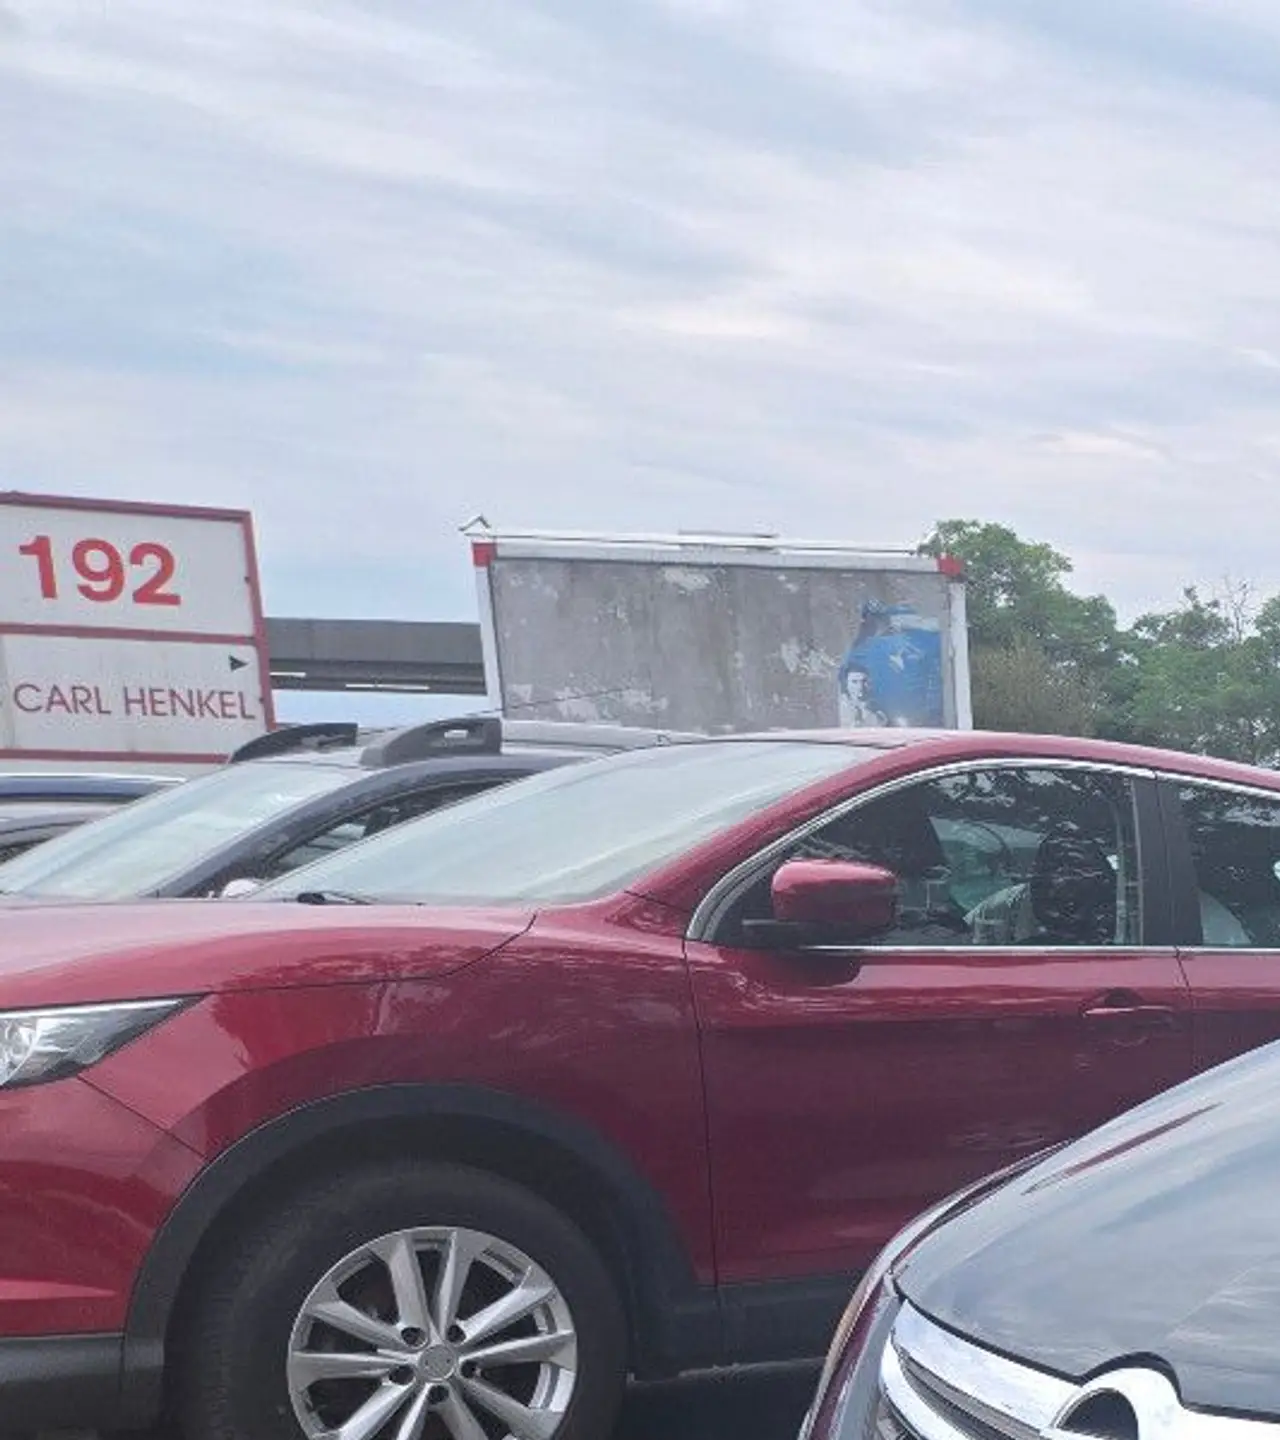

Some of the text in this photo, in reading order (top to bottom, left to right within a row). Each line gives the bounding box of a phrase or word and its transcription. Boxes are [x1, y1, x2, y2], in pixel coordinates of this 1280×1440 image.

[19, 535, 182, 605] 192
[14, 684, 257, 720] CARL HENKEL
